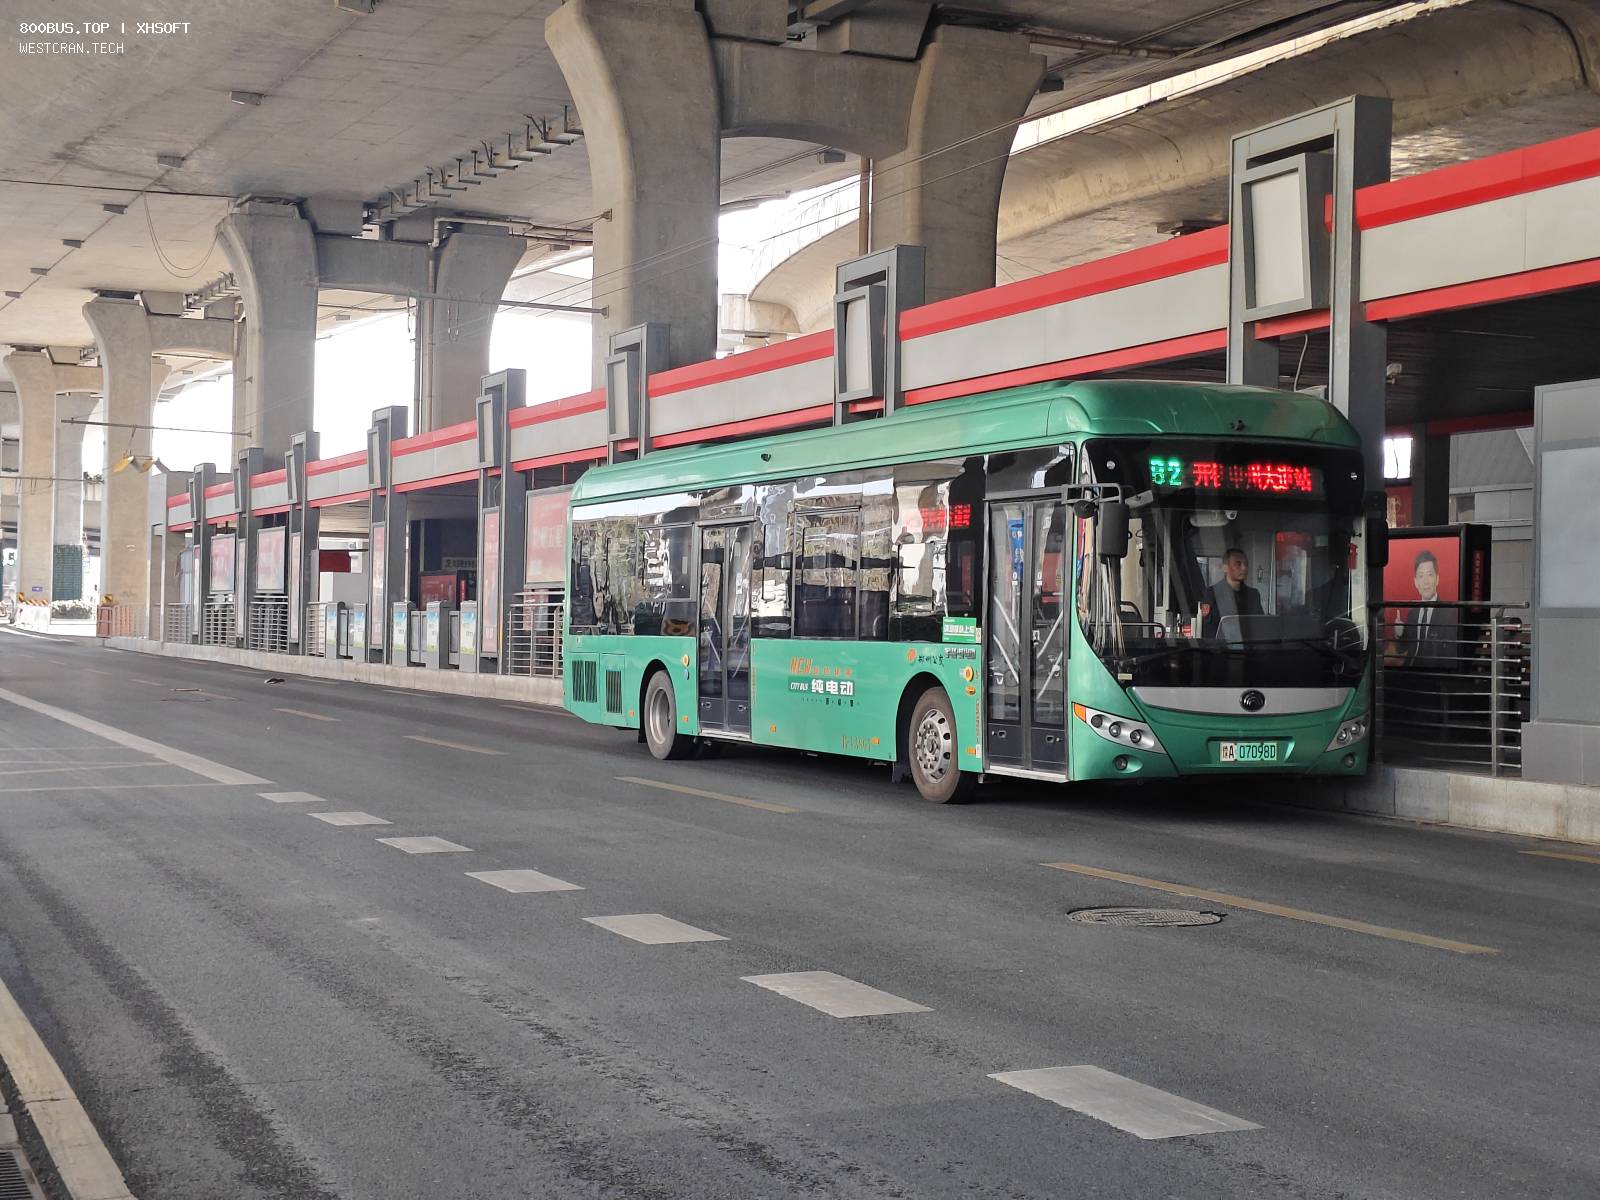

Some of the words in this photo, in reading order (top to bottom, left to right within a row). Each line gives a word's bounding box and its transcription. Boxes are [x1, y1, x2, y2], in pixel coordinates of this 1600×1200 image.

[811, 679, 854, 696] 纯电动
[1239, 745, 1276, 759] 07098D
